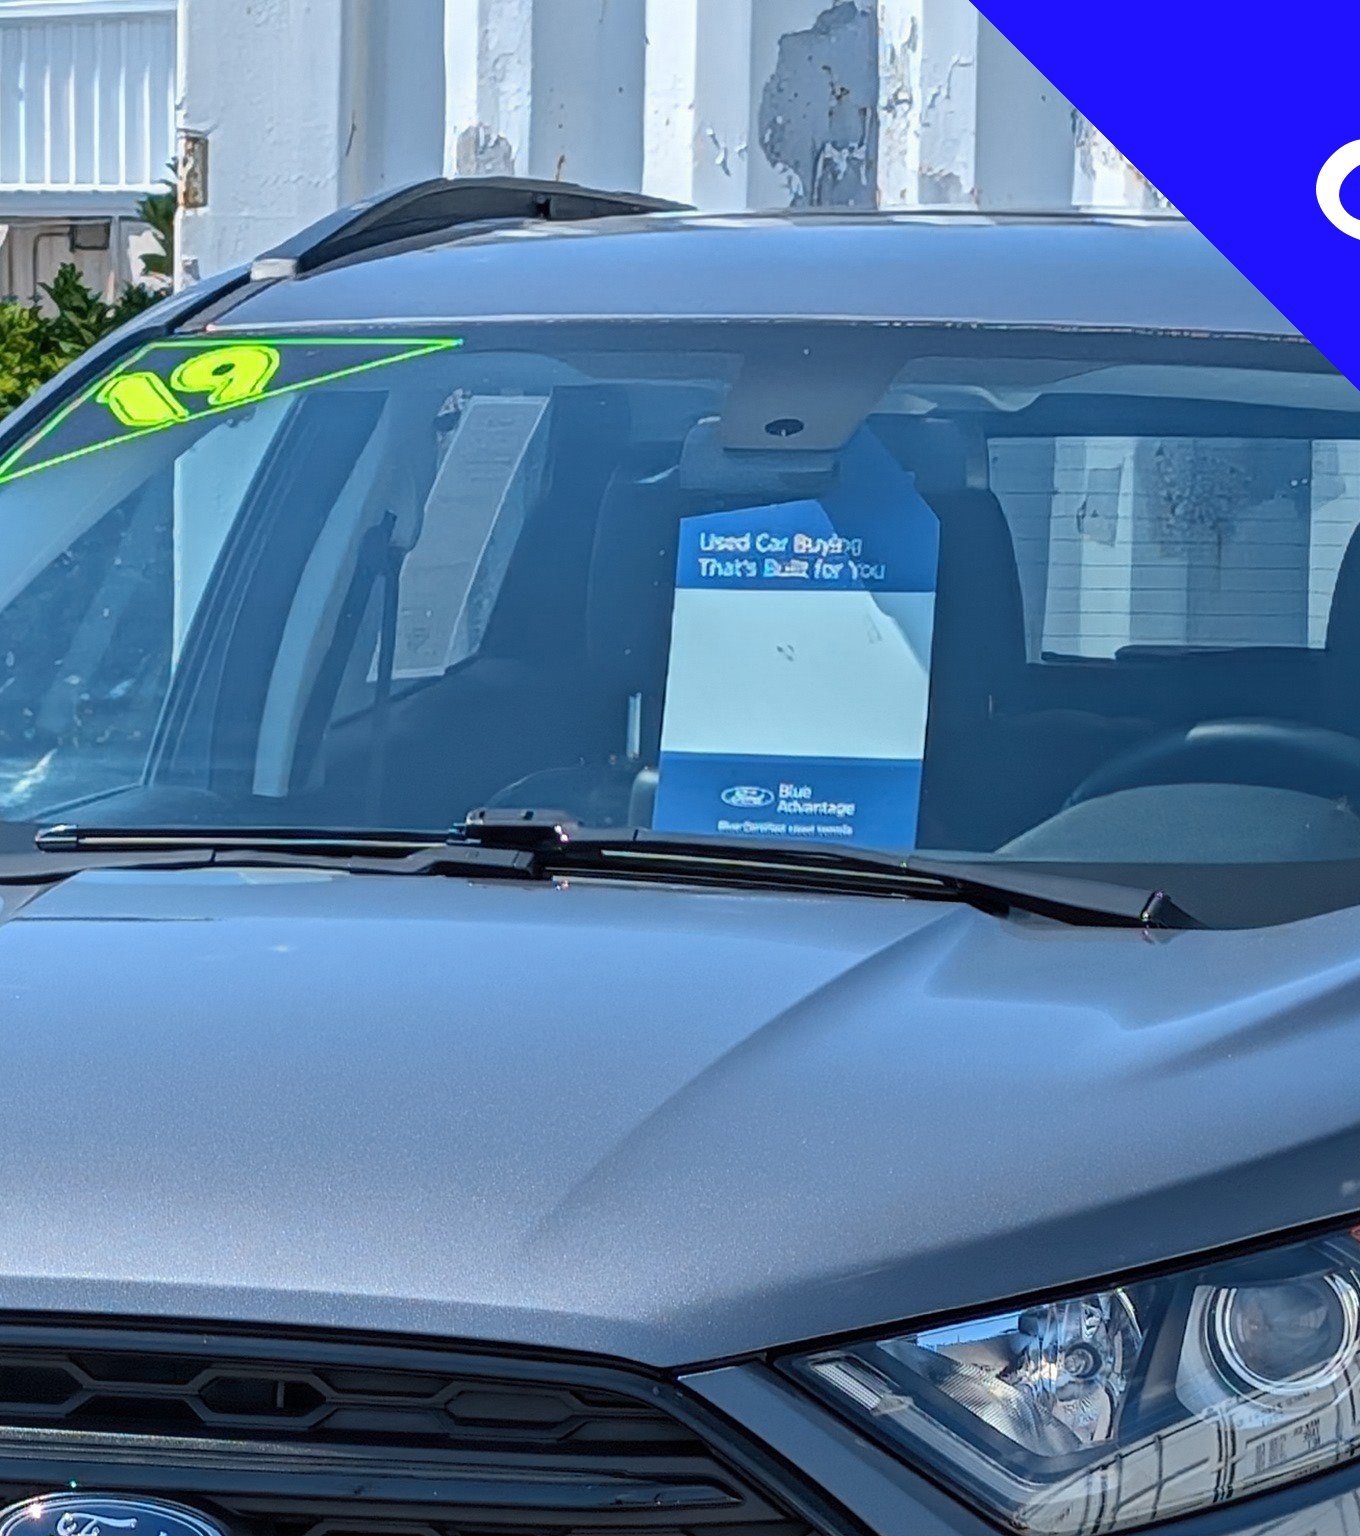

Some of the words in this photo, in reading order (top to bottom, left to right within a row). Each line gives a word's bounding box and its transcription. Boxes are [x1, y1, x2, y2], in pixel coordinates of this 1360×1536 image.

[97, 345, 280, 427] 19
[699, 531, 751, 552] Used
[755, 532, 789, 553] Car
[793, 532, 863, 557] Buying
[698, 557, 758, 578] That's
[762, 558, 810, 580] Built
[813, 557, 844, 580] for
[847, 560, 887, 580] You
[778, 783, 813, 800] Blue
[776, 799, 856, 818] Advantage
